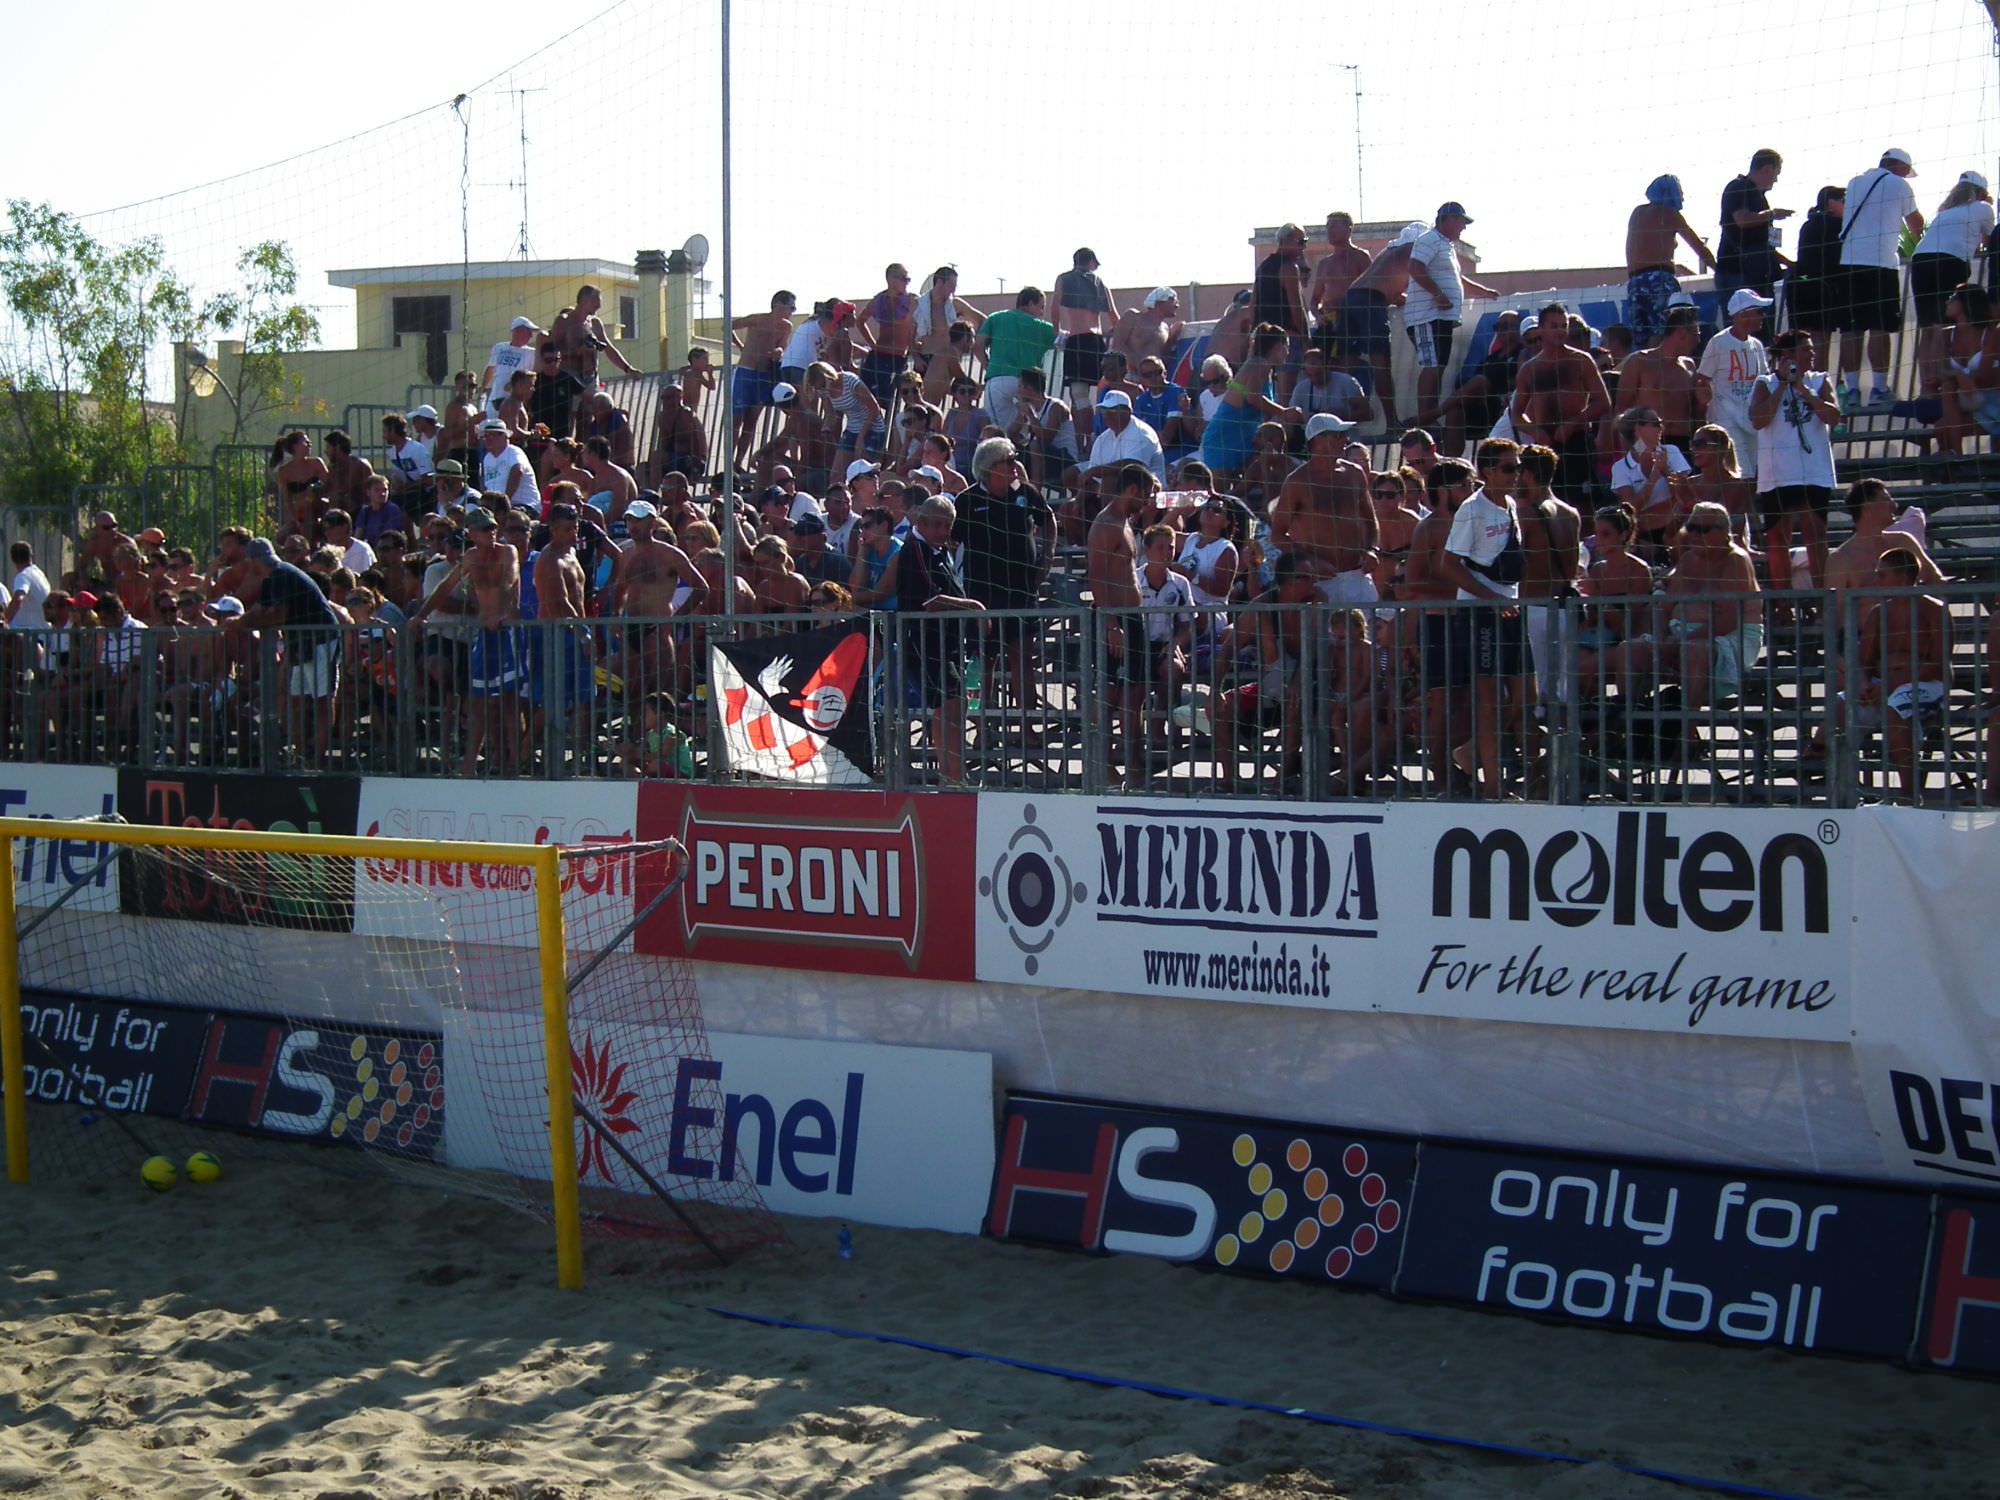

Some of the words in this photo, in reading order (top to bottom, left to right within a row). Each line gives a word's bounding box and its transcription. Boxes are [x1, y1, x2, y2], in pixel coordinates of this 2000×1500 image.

[695, 839, 901, 918] PERONI
[1097, 823, 1378, 920] MERINDA
[1432, 811, 1829, 933] molten
[1144, 940, 1330, 998] www.merinda.it
[1417, 944, 1492, 994] For
[1498, 944, 1576, 997] the
[1579, 951, 1687, 1003] real
[1688, 975, 1837, 1028] game
[20, 1002, 101, 1053] only
[110, 1008, 168, 1053] for
[3, 1063, 154, 1113] ootball
[191, 1020, 335, 1136] HS
[1890, 1070, 2000, 1165] DE
[668, 1058, 864, 1195] Enel
[990, 1114, 1217, 1260] HS
[1490, 1168, 1678, 1245] only
[1714, 1183, 1838, 1251] for
[1477, 1245, 1821, 1347] football
